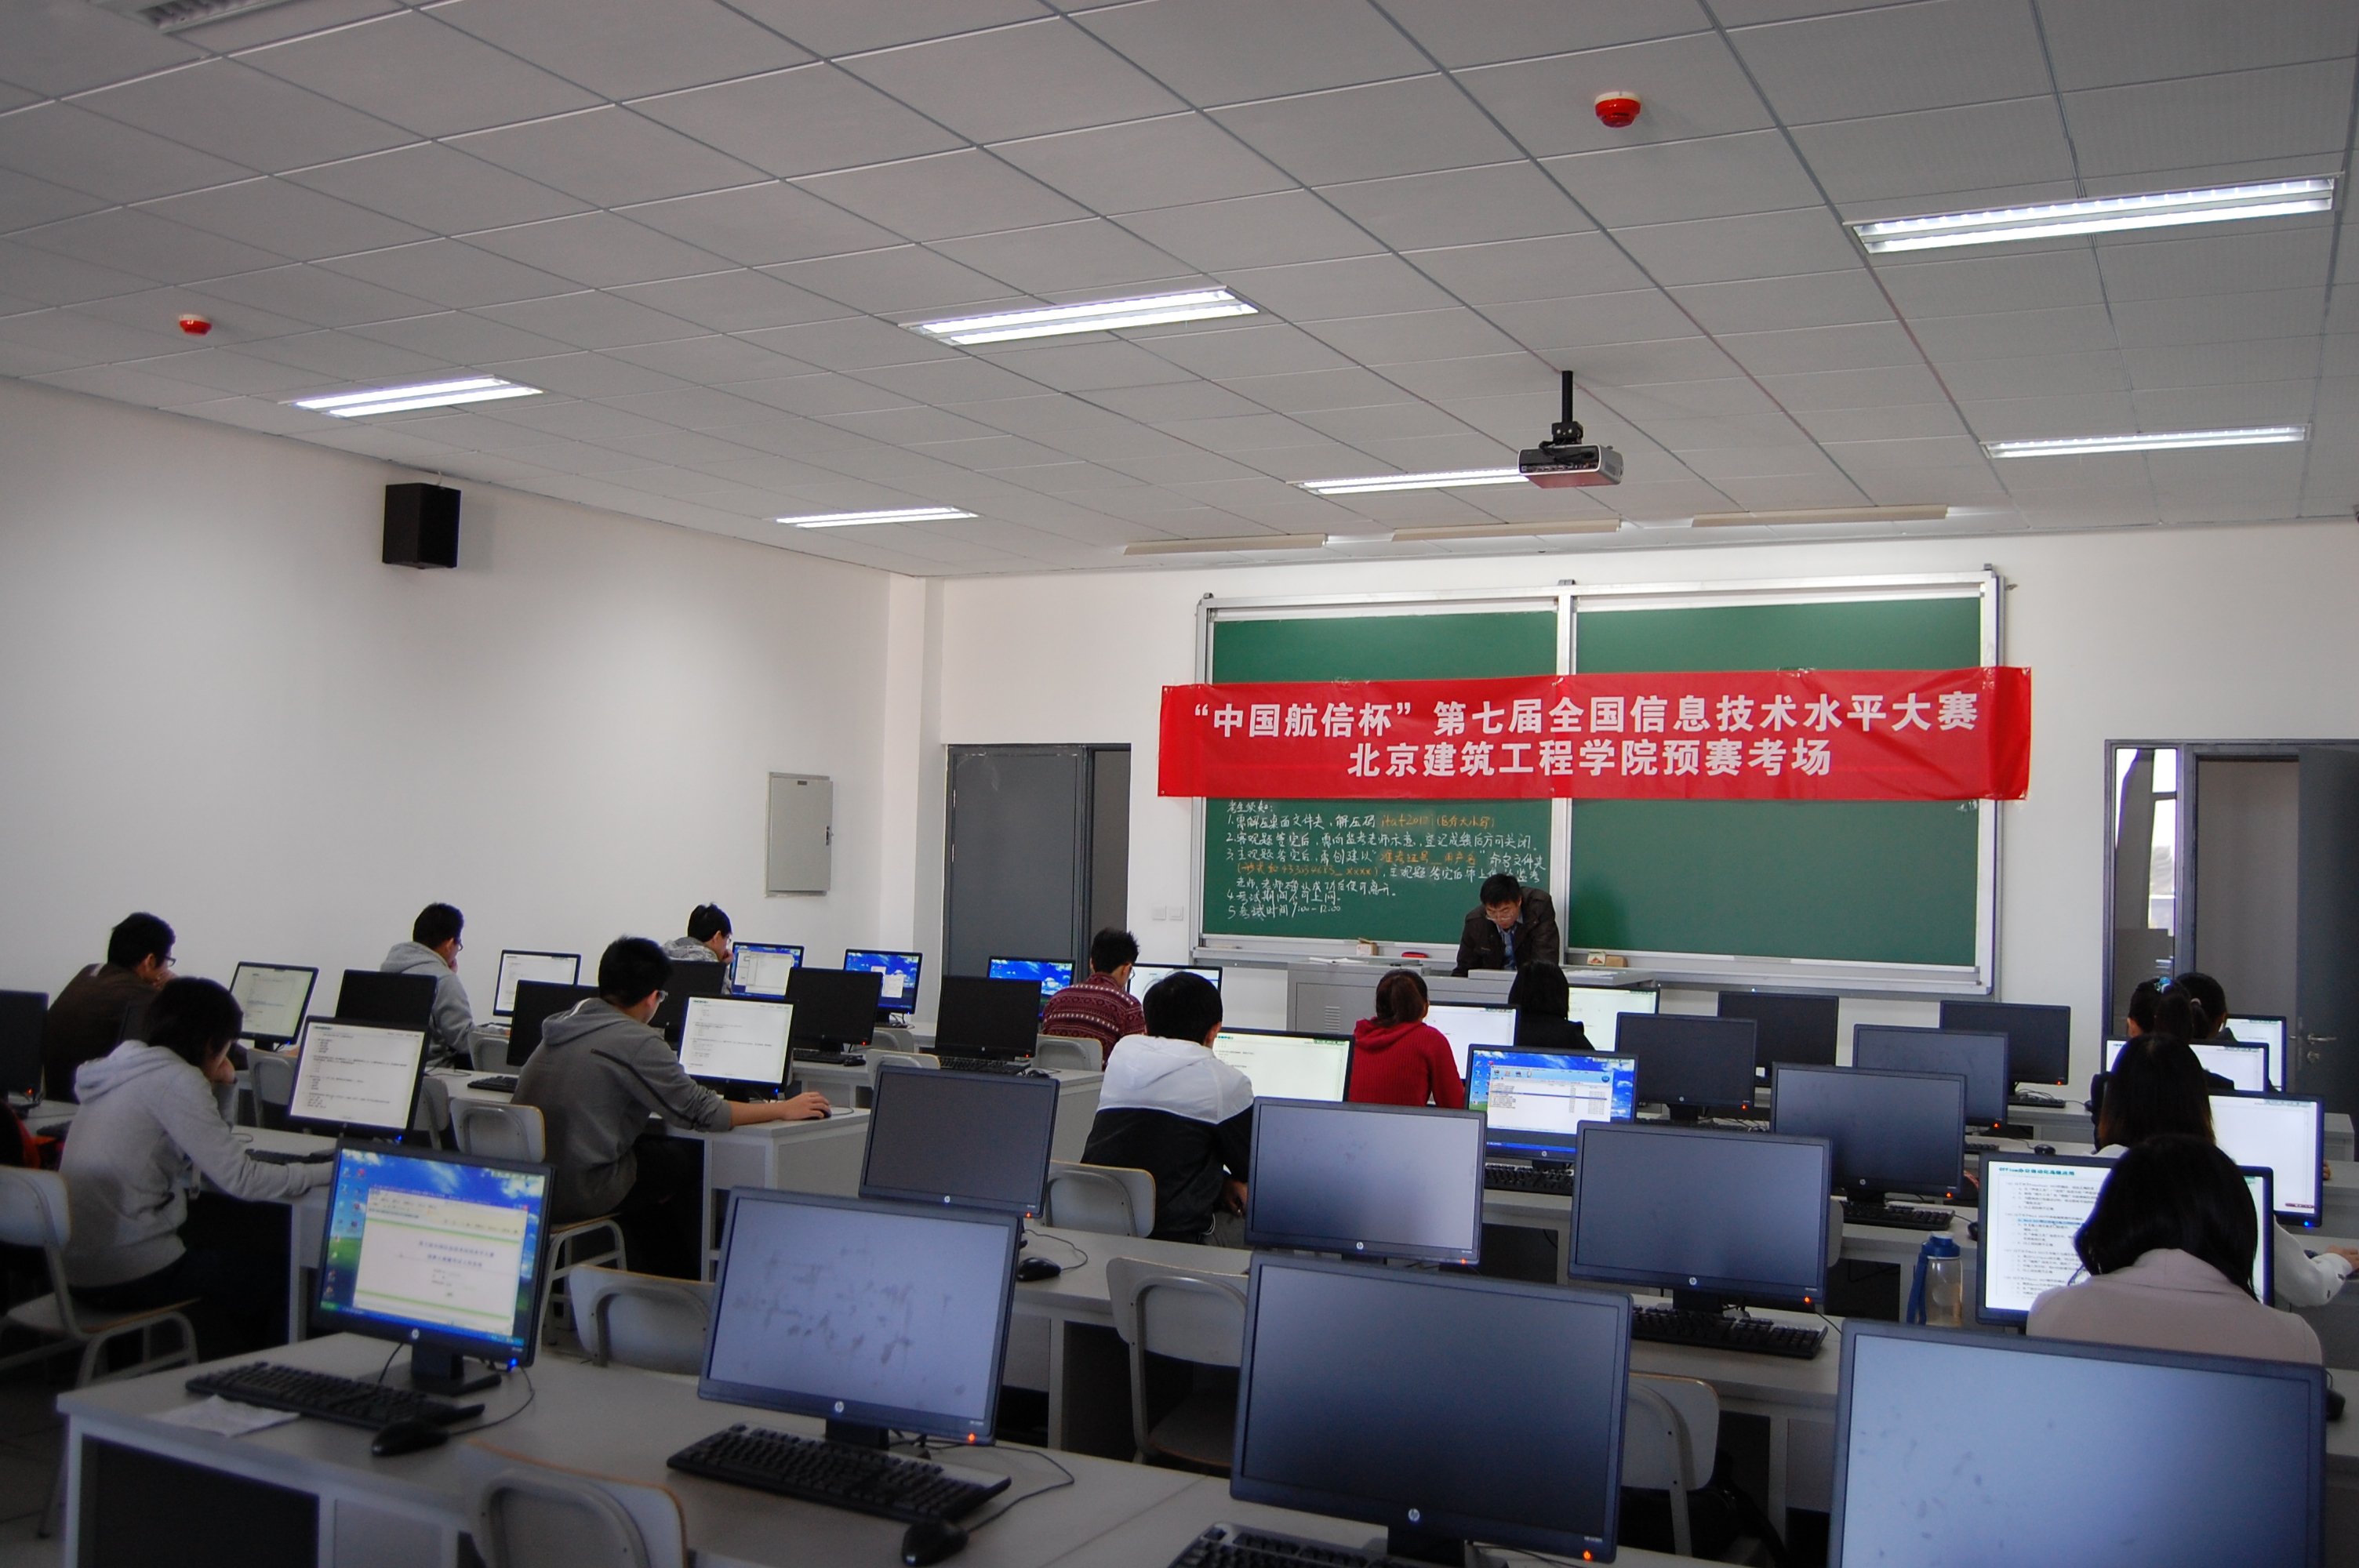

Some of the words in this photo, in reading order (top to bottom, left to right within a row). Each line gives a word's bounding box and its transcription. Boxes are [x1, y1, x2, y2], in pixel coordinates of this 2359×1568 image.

[1194, 702, 1411, 738] “中国航信杯”
[1434, 691, 1979, 736] 第七届全国信息技术水平大赛
[1347, 738, 1831, 778] 北京建筑工程学院预赛考场
